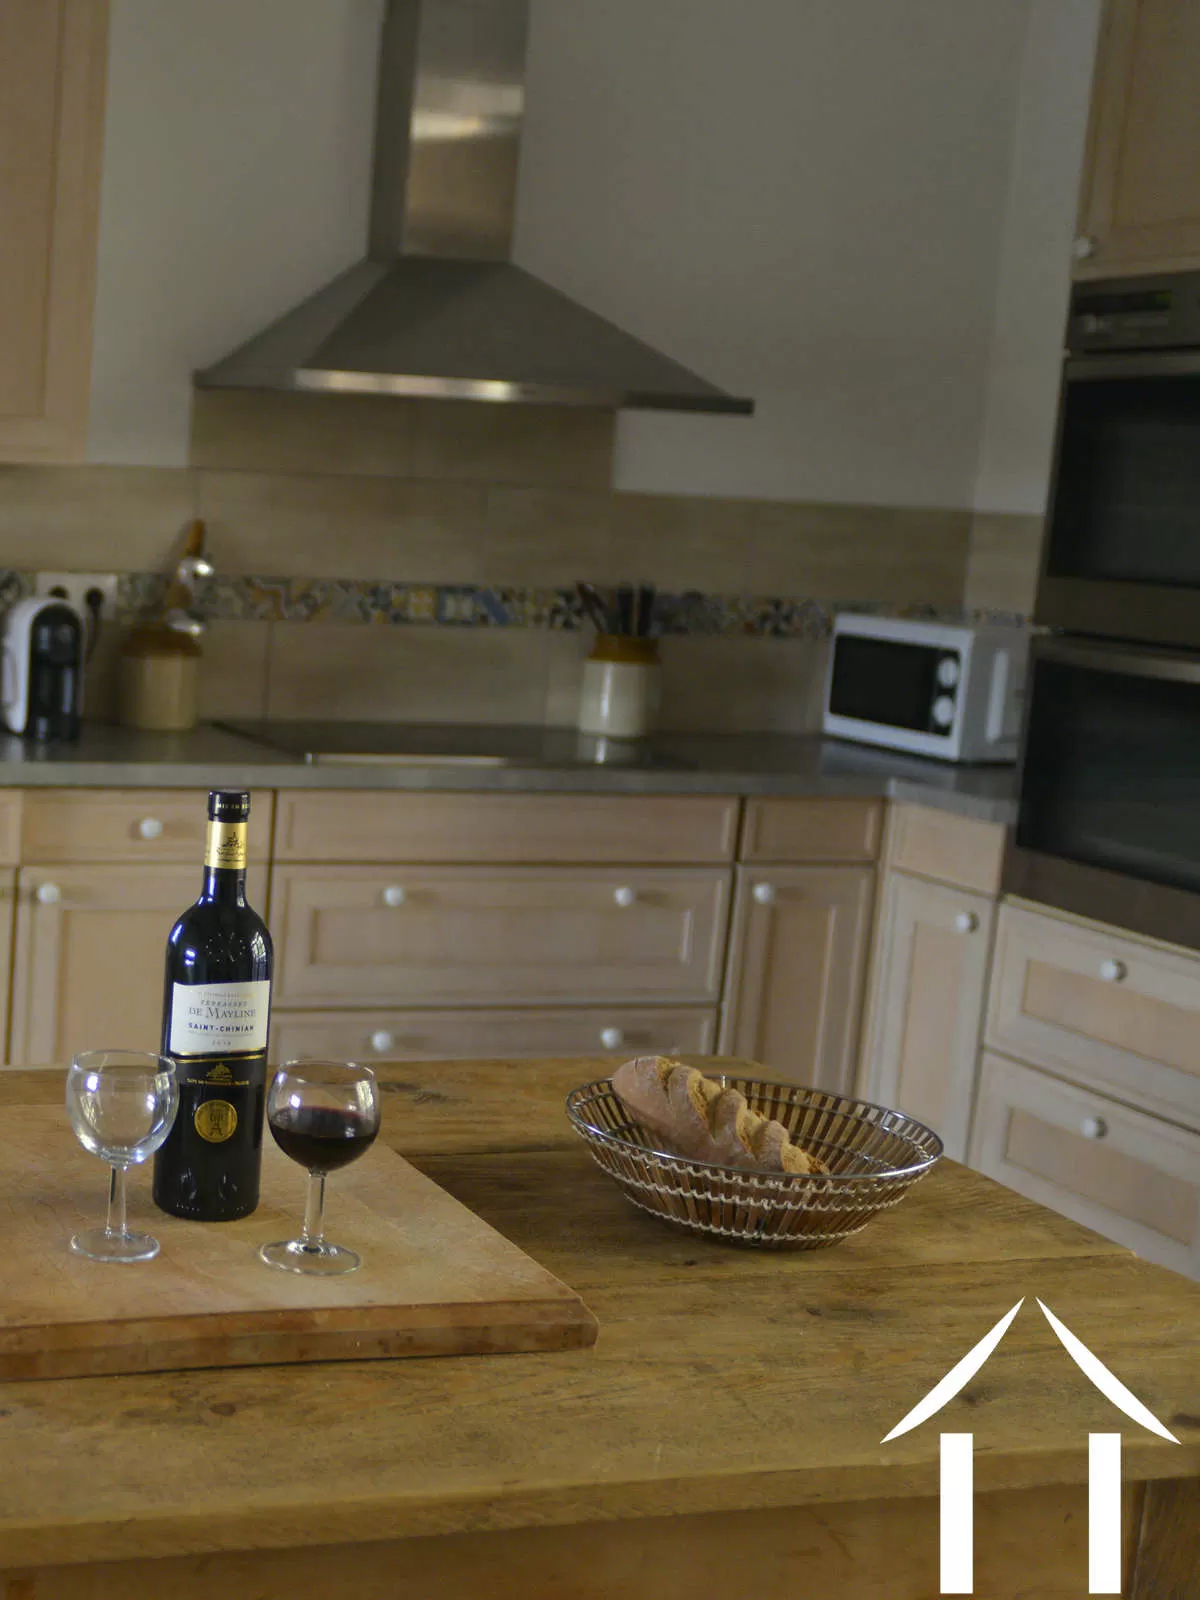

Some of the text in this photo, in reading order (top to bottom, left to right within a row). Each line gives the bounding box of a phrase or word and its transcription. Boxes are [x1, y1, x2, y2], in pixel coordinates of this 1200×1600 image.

[188, 1006, 256, 1019] DE MAYLINE
[188, 1022, 254, 1032] SAINT-CHINIAN
